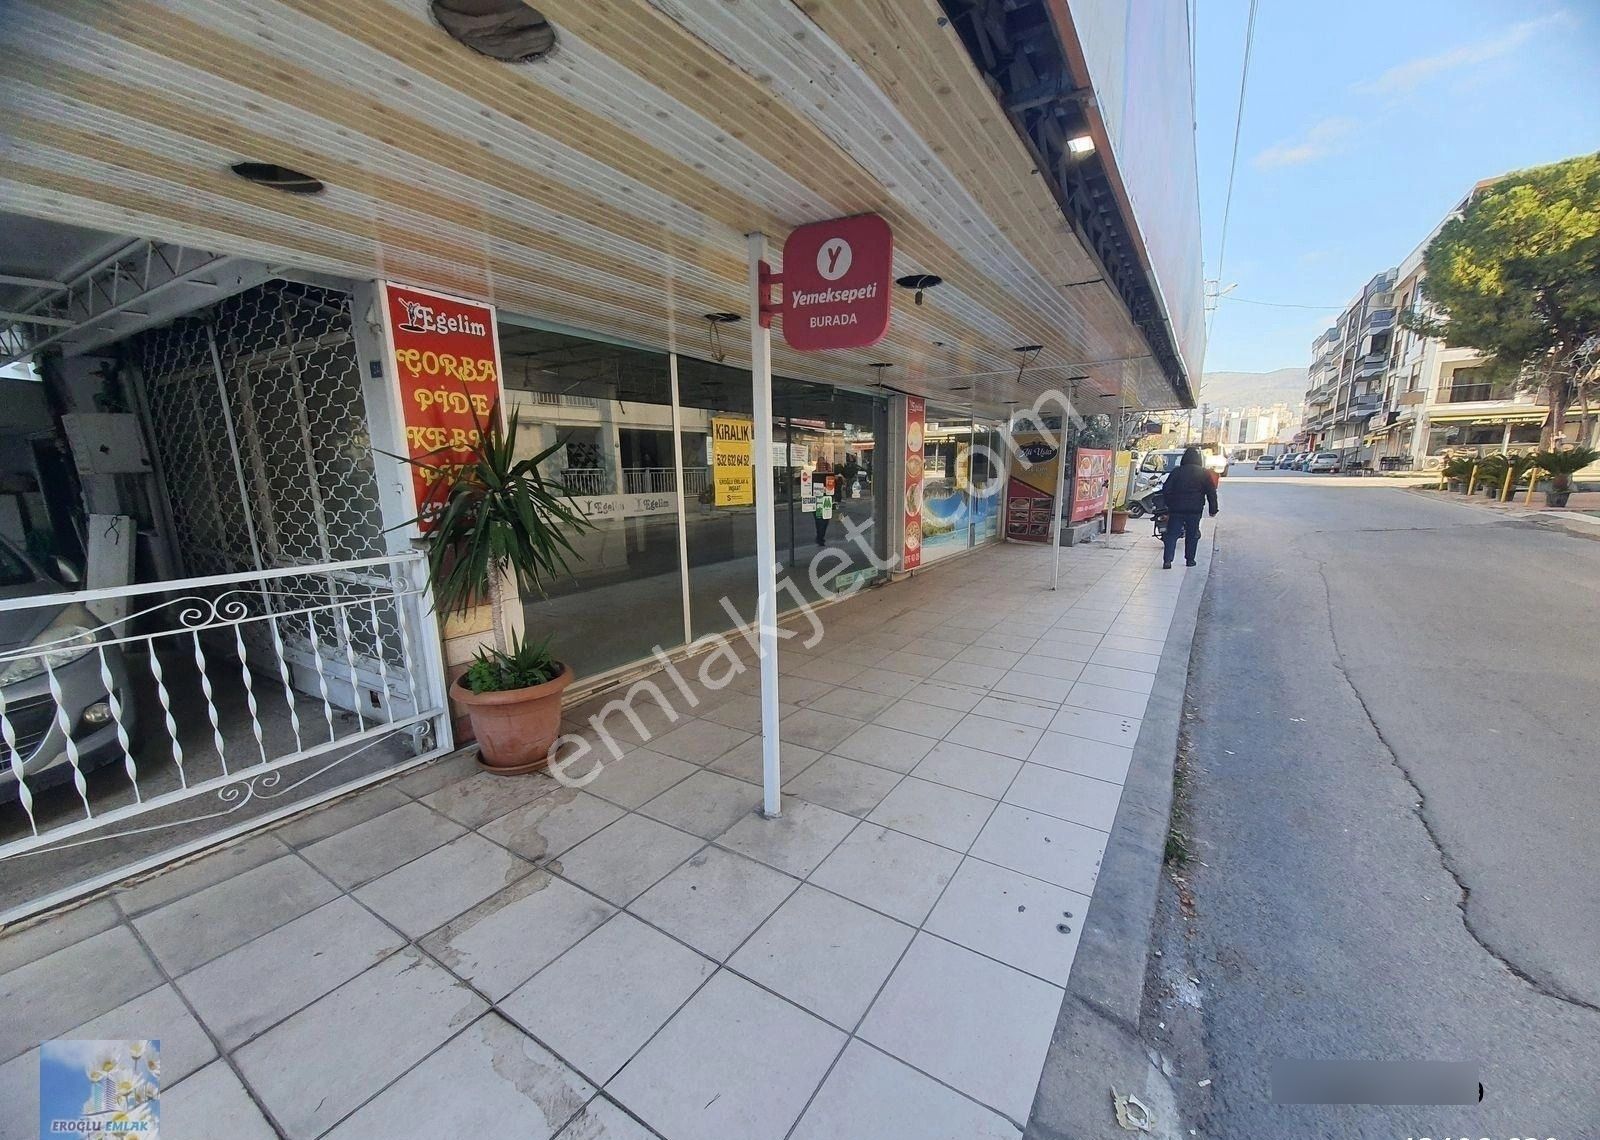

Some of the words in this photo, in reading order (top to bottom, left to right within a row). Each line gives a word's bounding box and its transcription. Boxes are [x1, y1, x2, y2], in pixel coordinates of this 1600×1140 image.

[827, 245, 842, 273] Y
[792, 282, 877, 309] Yemeksepeti
[414, 306, 486, 337] Egelim
[810, 313, 857, 328] BURADA
[395, 348, 497, 382] ÇORBA
[413, 385, 490, 416] PİDE
[406, 426, 497, 453] KEB
